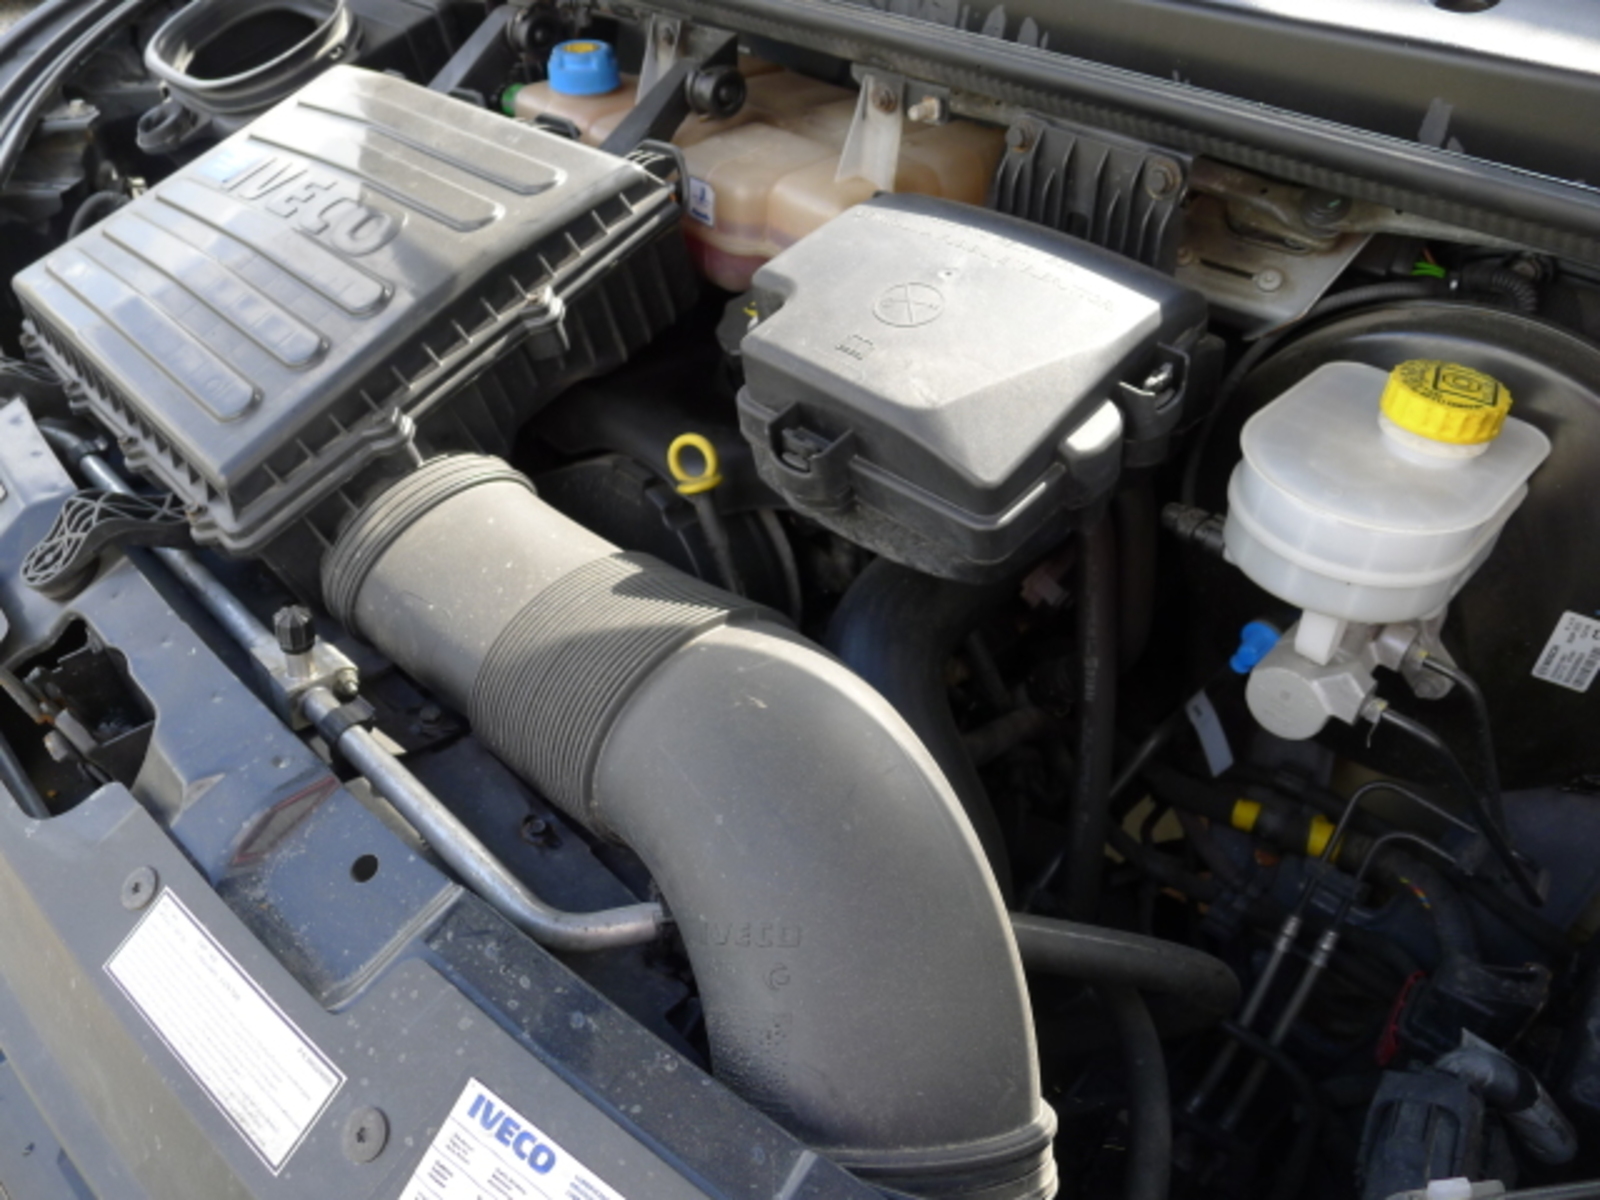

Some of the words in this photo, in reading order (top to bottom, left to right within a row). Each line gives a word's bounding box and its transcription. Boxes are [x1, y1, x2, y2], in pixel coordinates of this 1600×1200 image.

[223, 155, 399, 257] IVECO
[701, 921, 801, 948] IVECO
[467, 1094, 556, 1174] IVECO
